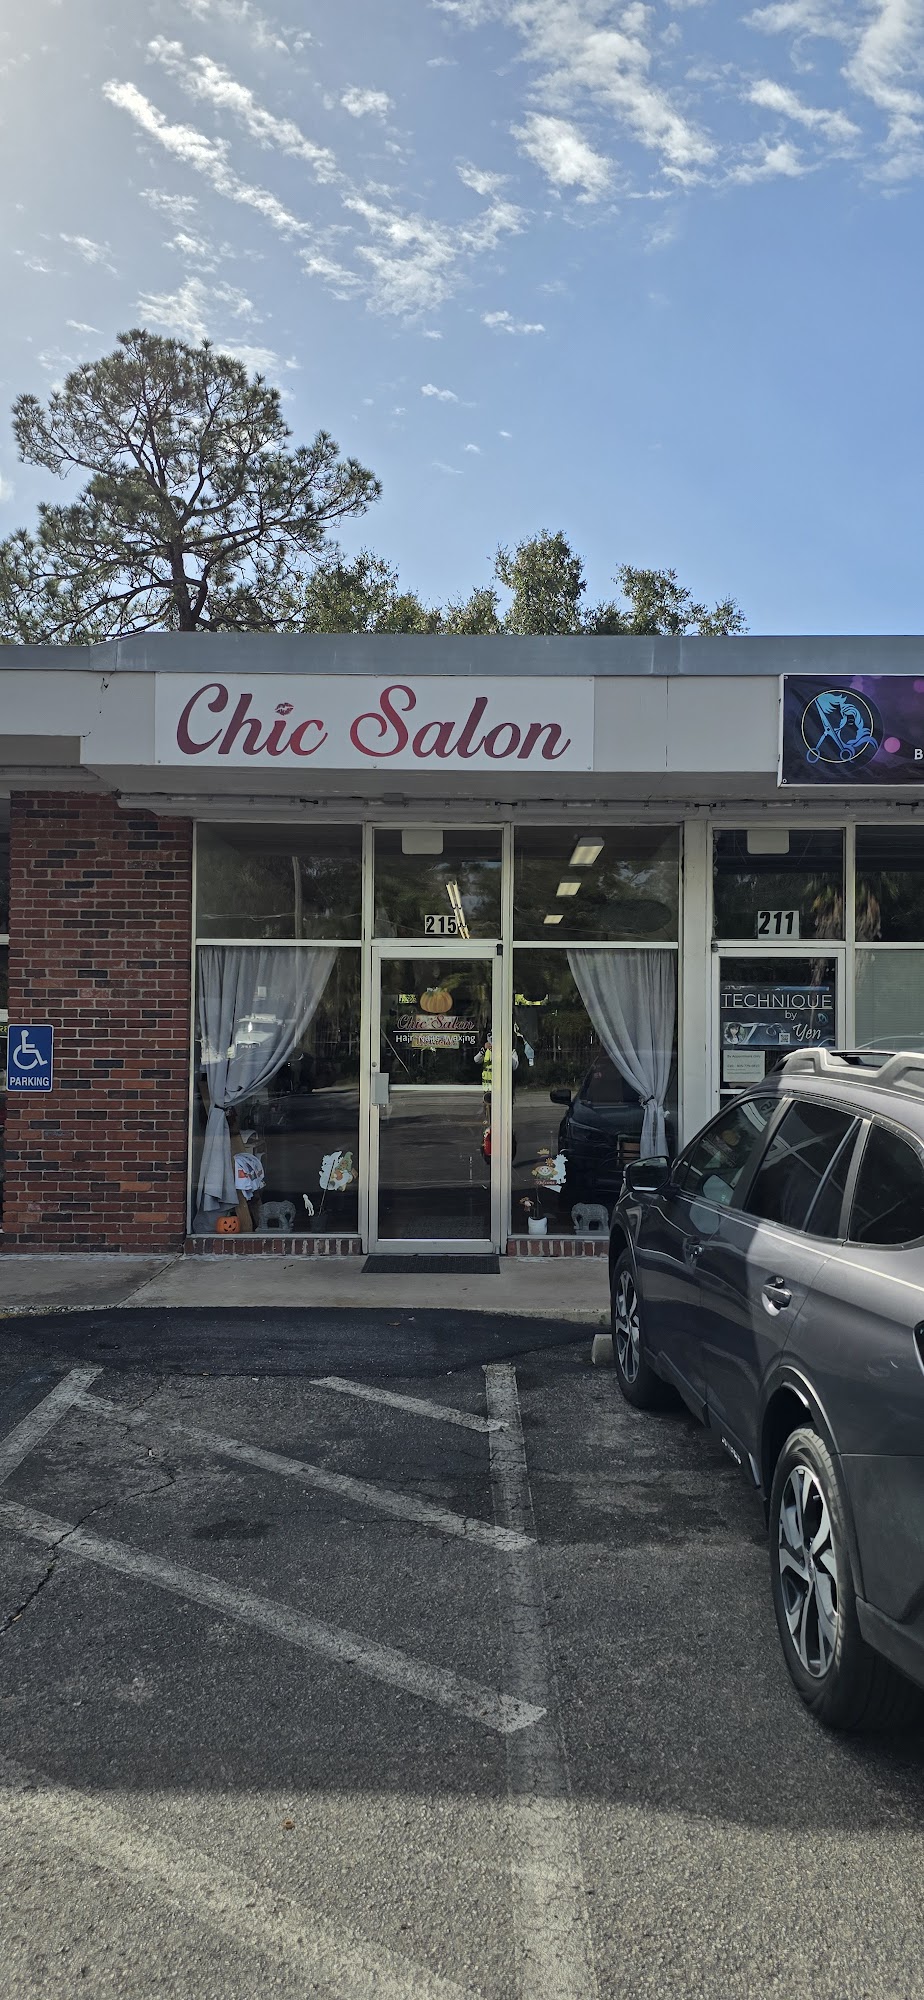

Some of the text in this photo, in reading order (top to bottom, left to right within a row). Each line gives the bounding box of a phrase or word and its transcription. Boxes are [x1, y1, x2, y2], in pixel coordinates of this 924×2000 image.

[176, 682, 571, 760] Chic Salon
[426, 915, 456, 933] 215
[758, 911, 794, 935] 211
[721, 993, 832, 1010] TECHNIQUE
[397, 1014, 475, 1030] Chic Salon
[785, 1010, 797, 1021] by
[395, 1034, 414, 1044] Hair
[792, 1023, 822, 1041] Yen
[9, 1076, 50, 1087] PARKING
